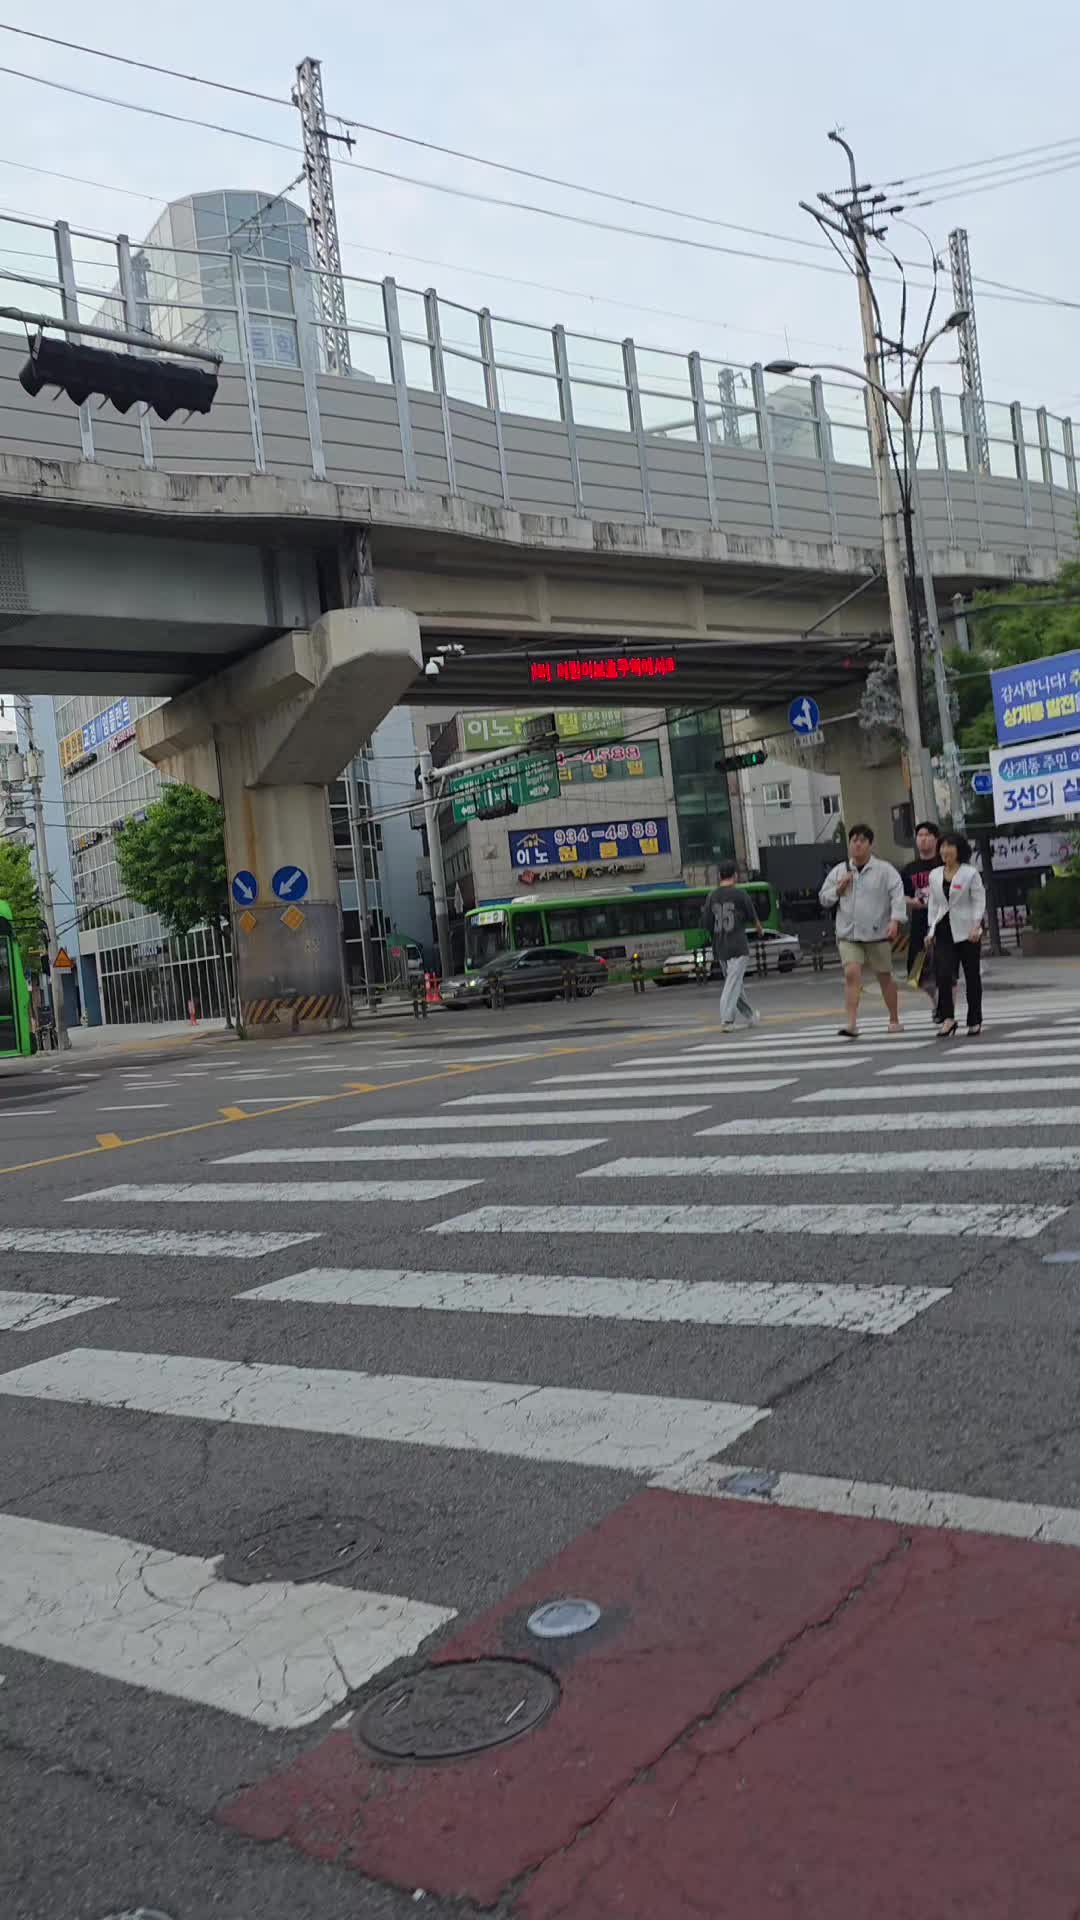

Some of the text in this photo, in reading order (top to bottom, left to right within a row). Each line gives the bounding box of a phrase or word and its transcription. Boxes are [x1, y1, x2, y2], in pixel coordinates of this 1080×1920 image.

[468, 718, 512, 741] 이노
[1003, 759, 1041, 780] 상계동
[1042, 752, 1068, 771] 주민
[1003, 781, 1054, 811] 3선의
[554, 820, 658, 846] 934-4588
[516, 847, 549, 865] 이노
